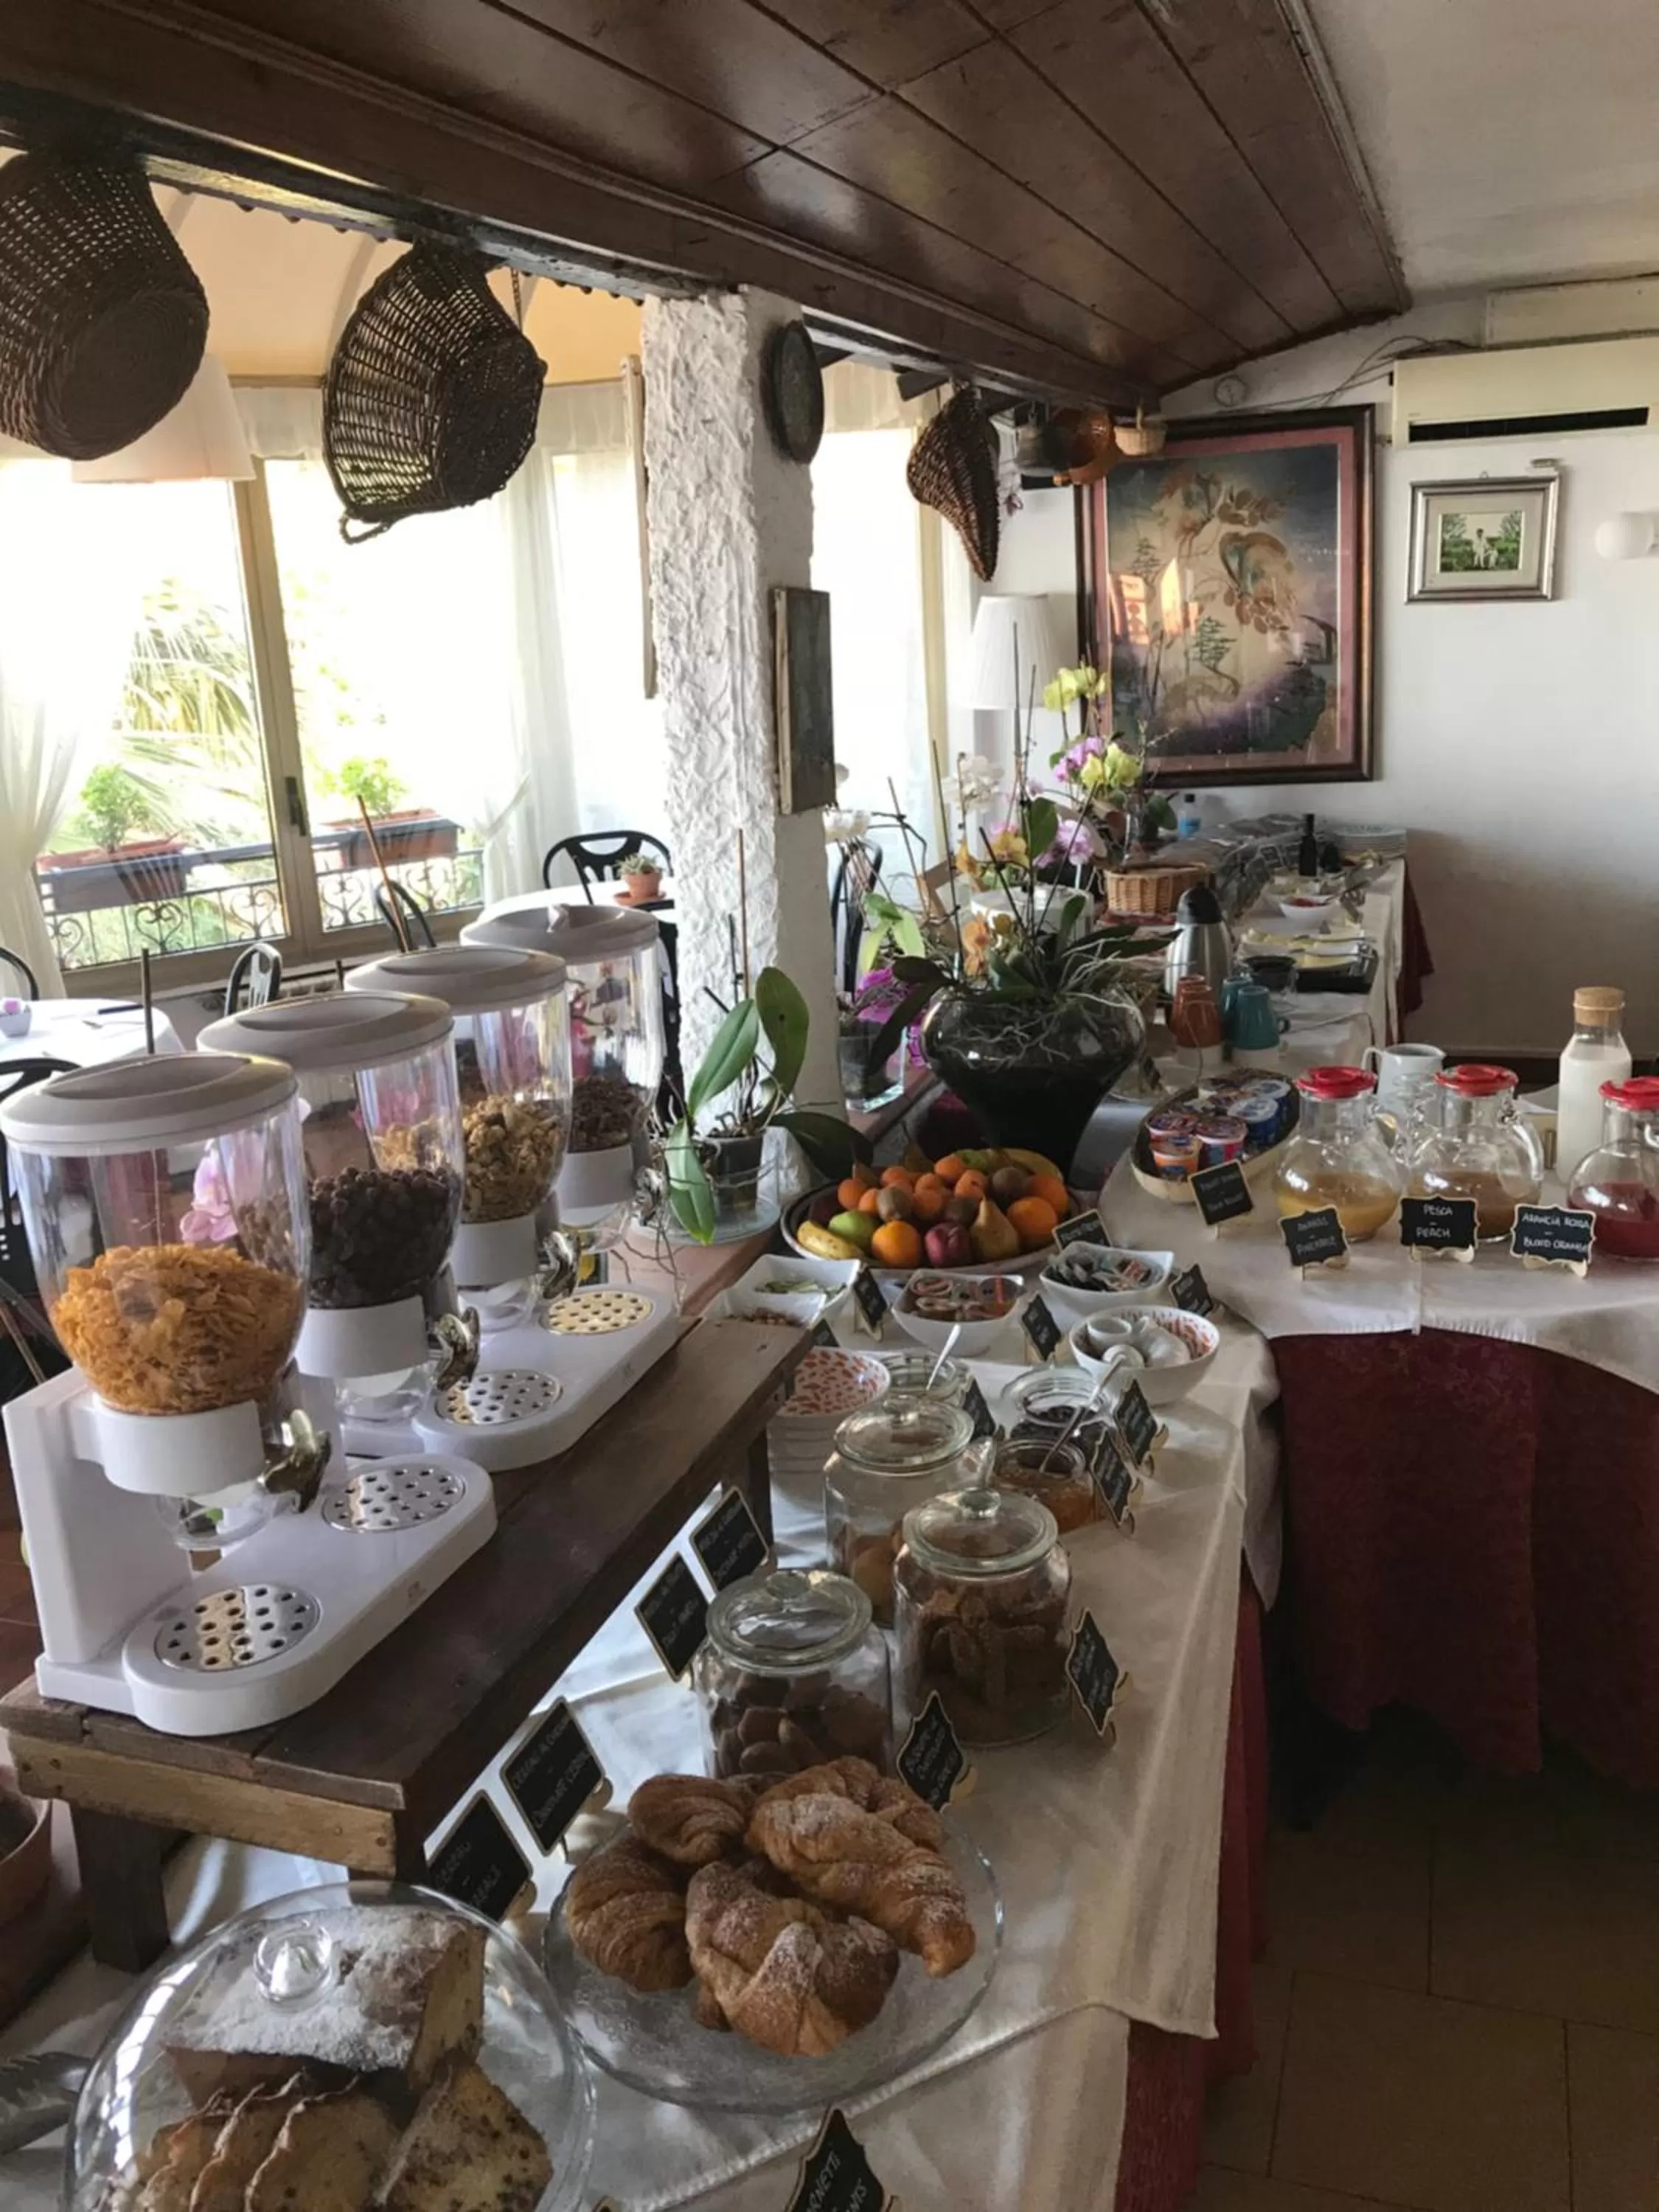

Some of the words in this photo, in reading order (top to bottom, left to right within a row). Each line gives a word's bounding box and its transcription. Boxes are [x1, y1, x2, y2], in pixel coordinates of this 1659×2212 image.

[1423, 1203, 1453, 1216] PESCA
[1521, 1212, 1562, 1227] ARANCIA
[1416, 1226, 1451, 1239] PEACH
